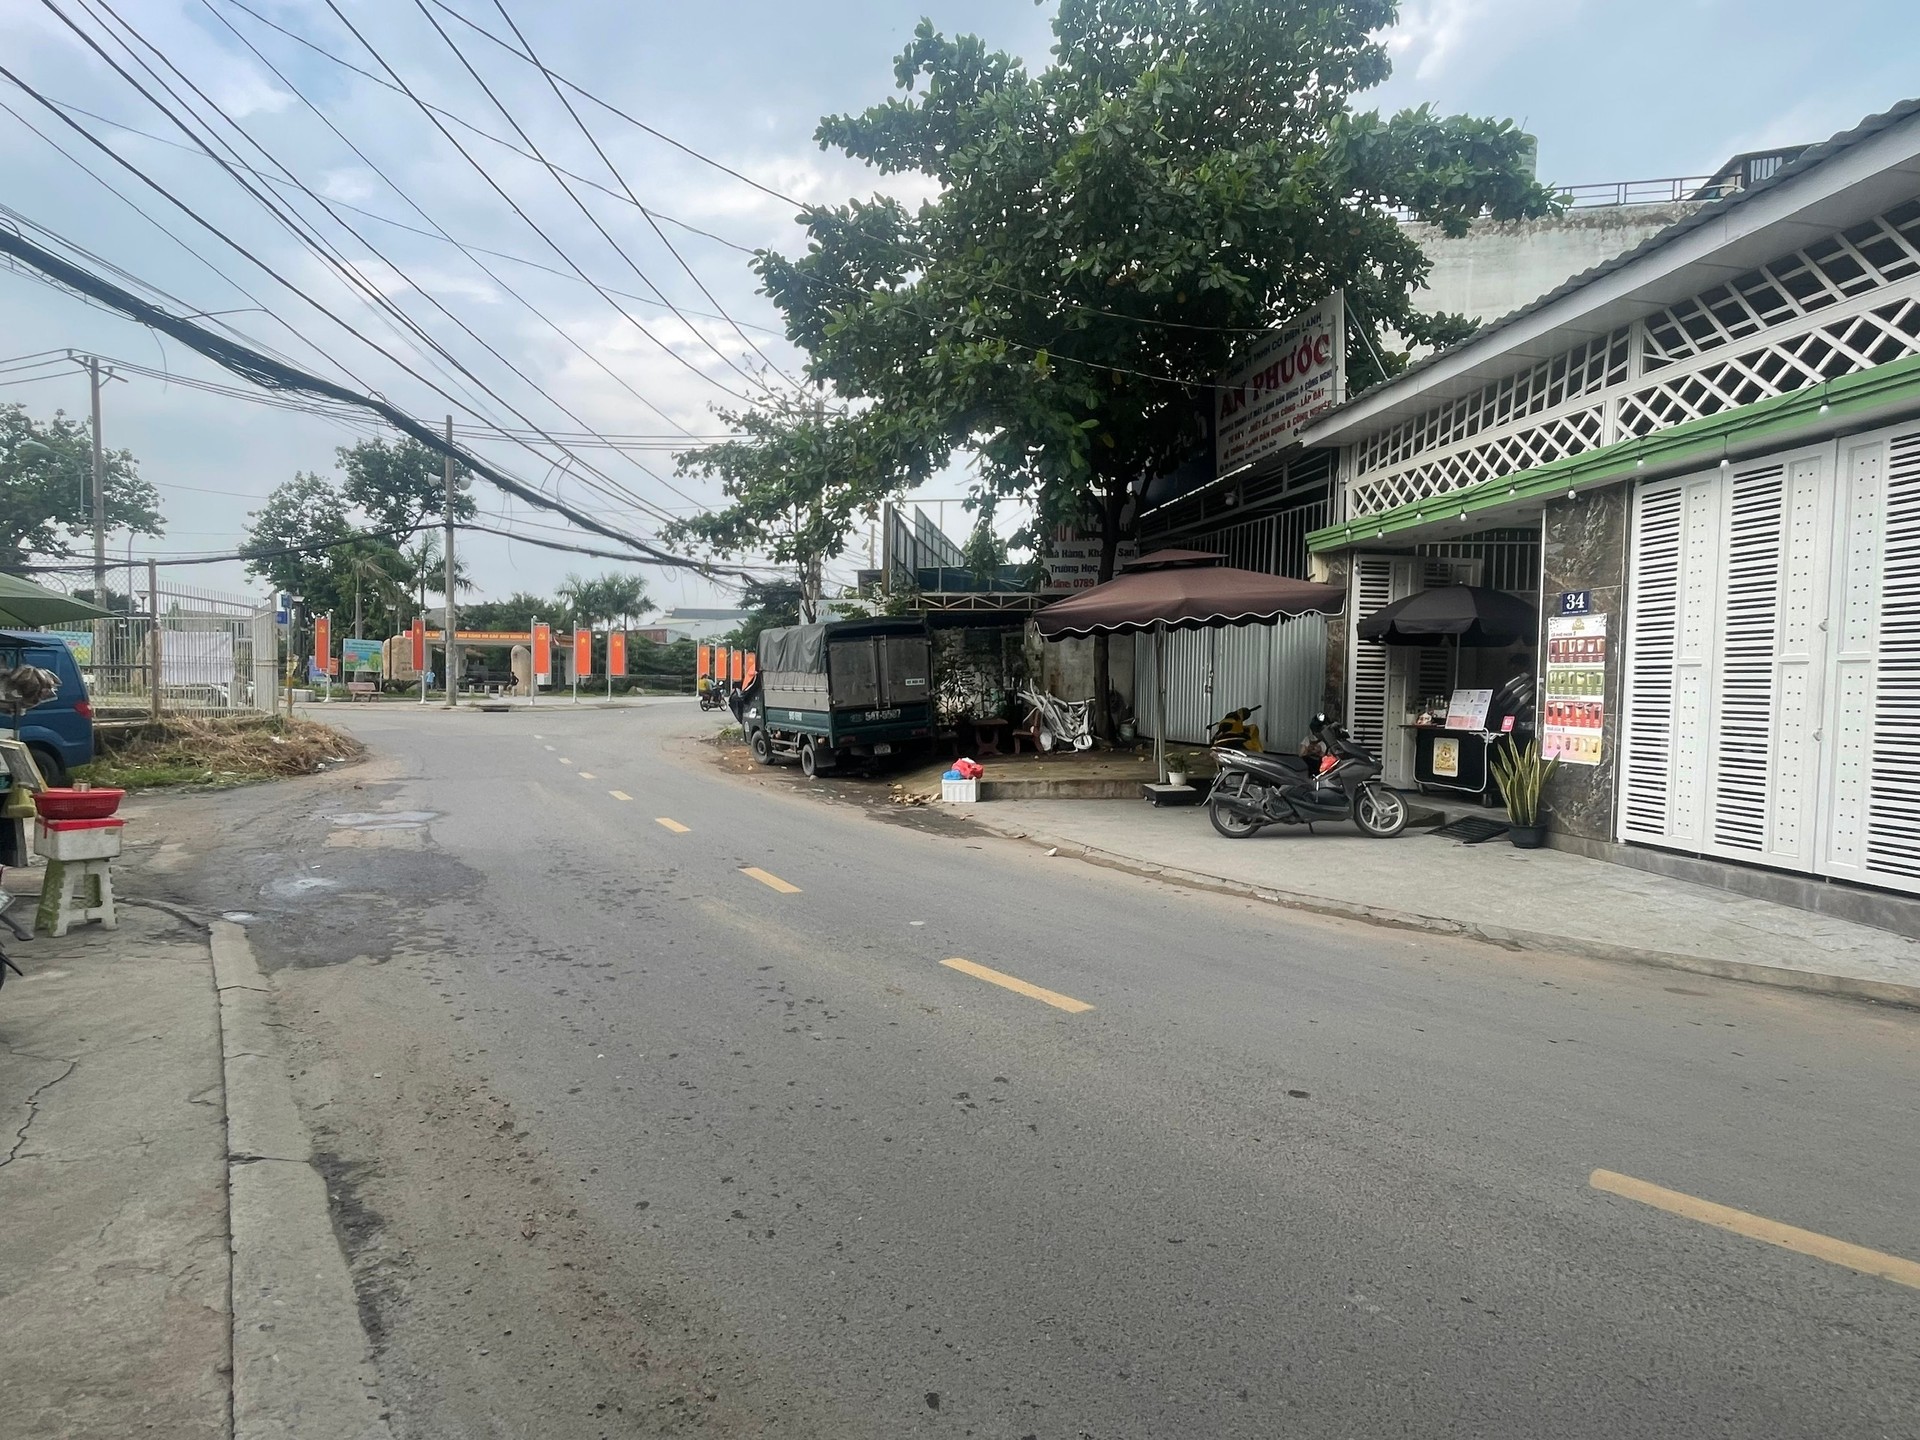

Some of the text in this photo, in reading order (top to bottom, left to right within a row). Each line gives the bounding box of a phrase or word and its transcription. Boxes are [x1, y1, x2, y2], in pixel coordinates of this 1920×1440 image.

[1252, 333, 1330, 401] PHƯỚC
[1050, 564, 1078, 574] Trường
[1074, 578, 1094, 588] 0789
[1566, 592, 1584, 610] 34
